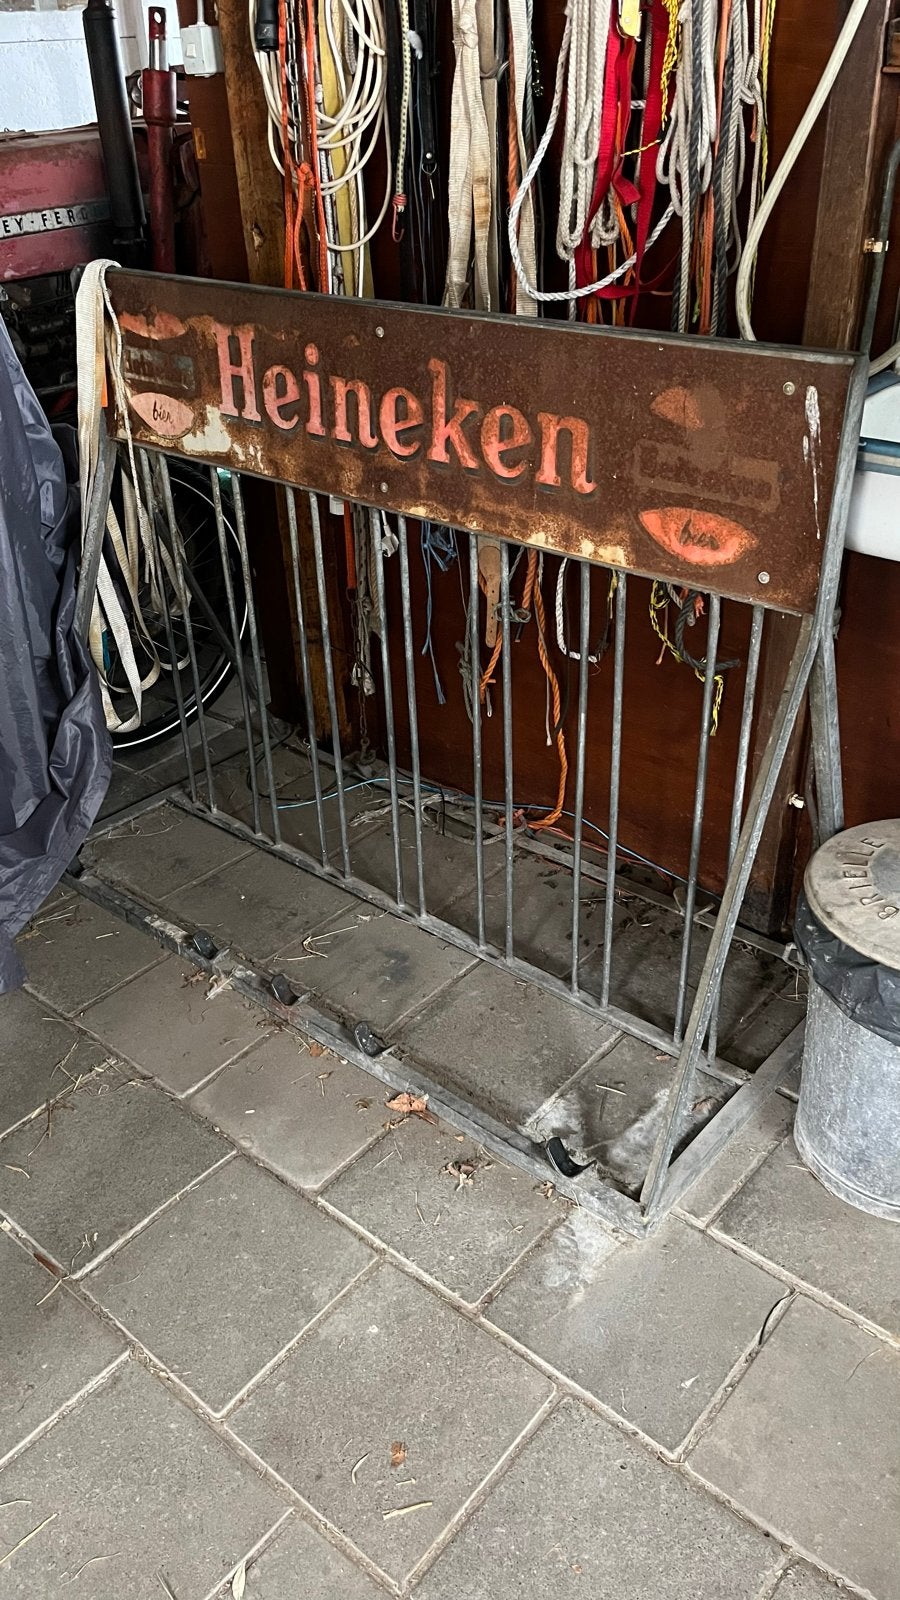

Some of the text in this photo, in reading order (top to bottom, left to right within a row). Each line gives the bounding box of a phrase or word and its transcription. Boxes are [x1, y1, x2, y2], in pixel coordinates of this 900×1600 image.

[152, 400, 174, 425] bier
[211, 323, 599, 495] Heineken
[842, 837, 900, 921] BRIELLE
